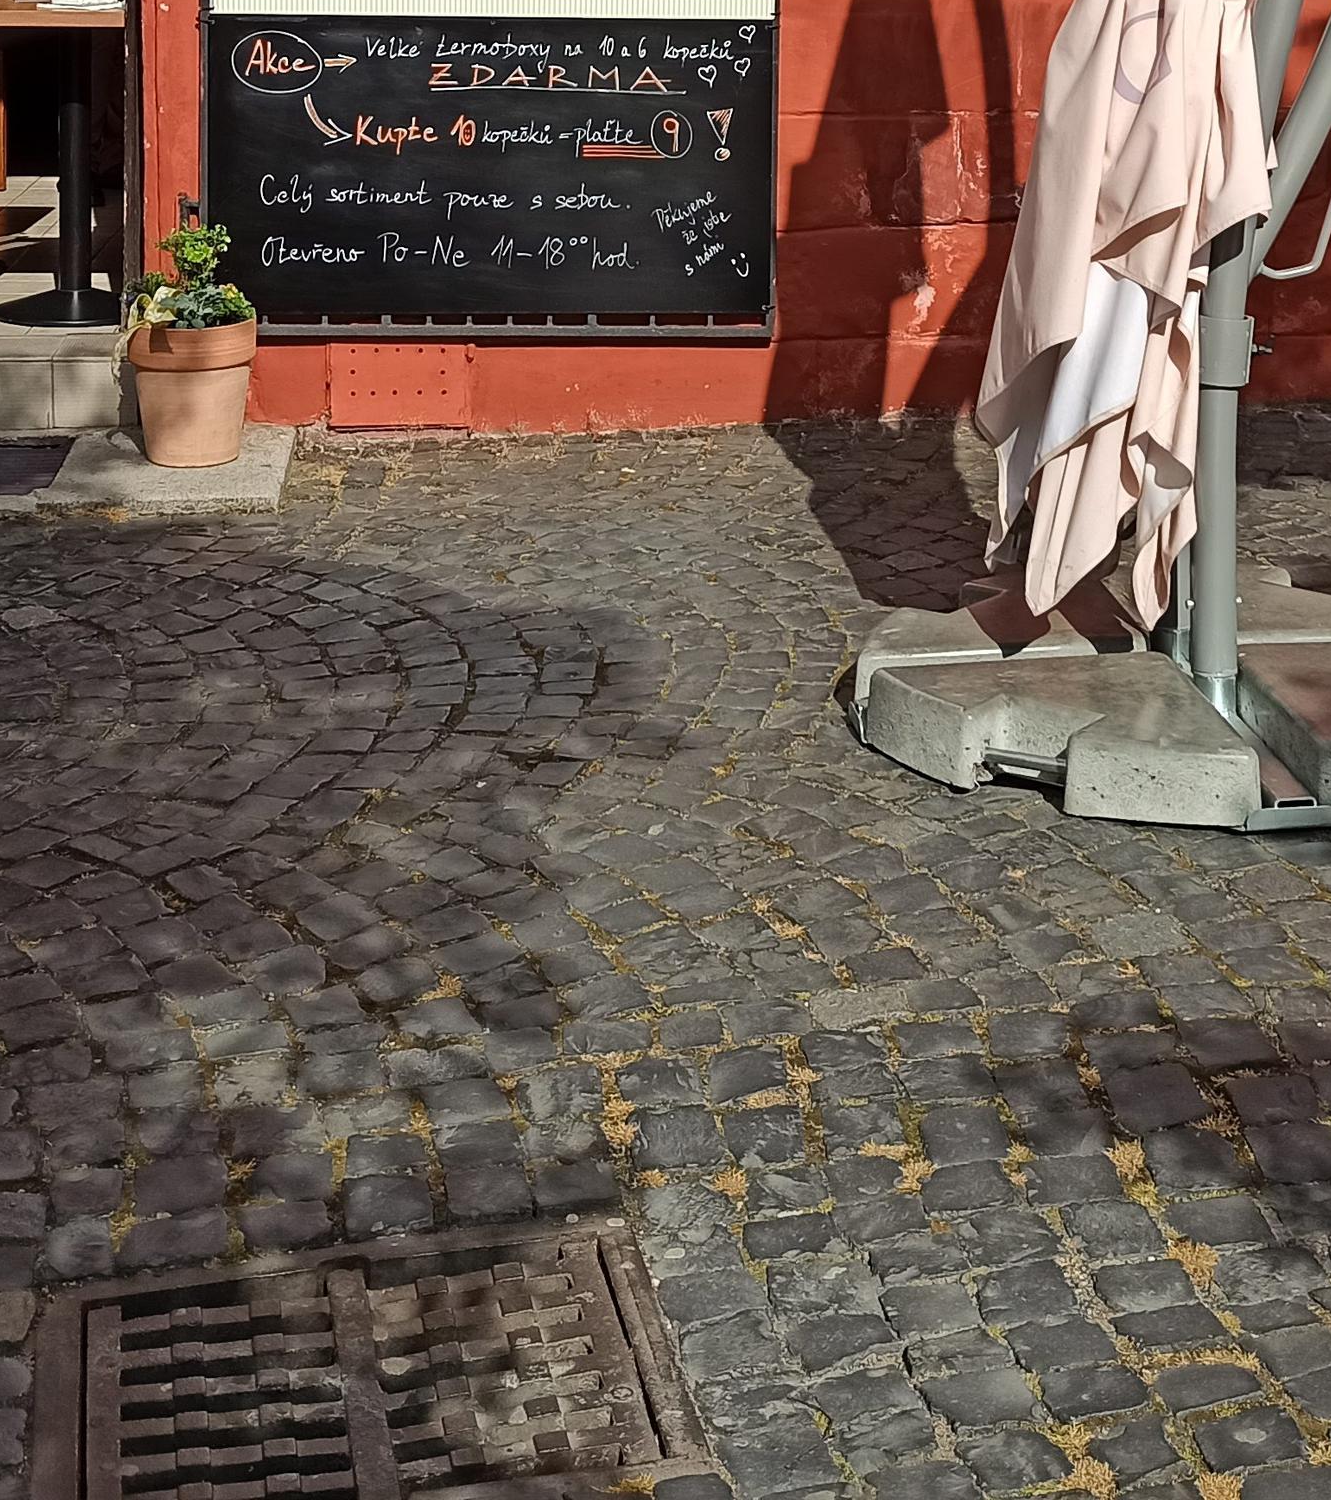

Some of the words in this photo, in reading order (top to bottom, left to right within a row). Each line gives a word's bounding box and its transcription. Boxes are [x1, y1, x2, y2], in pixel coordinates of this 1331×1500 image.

[244, 38, 318, 78] Akce
[366, 36, 424, 58] Velké
[435, 33, 551, 74] termoboxy
[564, 42, 584, 57] na
[599, 34, 616, 57] 10
[621, 43, 632, 58] a
[638, 35, 648, 58] 6
[664, 34, 736, 68] kopečků
[428, 62, 673, 94] ZDARMA
[355, 115, 438, 155] Kupte
[450, 113, 477, 147] 10
[481, 124, 554, 153] kopečků
[662, 117, 681, 153] 9
[260, 173, 314, 214] Celý
[325, 180, 433, 206] sortiment
[442, 191, 515, 220] pouze
[529, 194, 543, 210] s
[261, 236, 366, 268] Otevřeno
[681, 229, 699, 246] že
[684, 263, 695, 277] s
